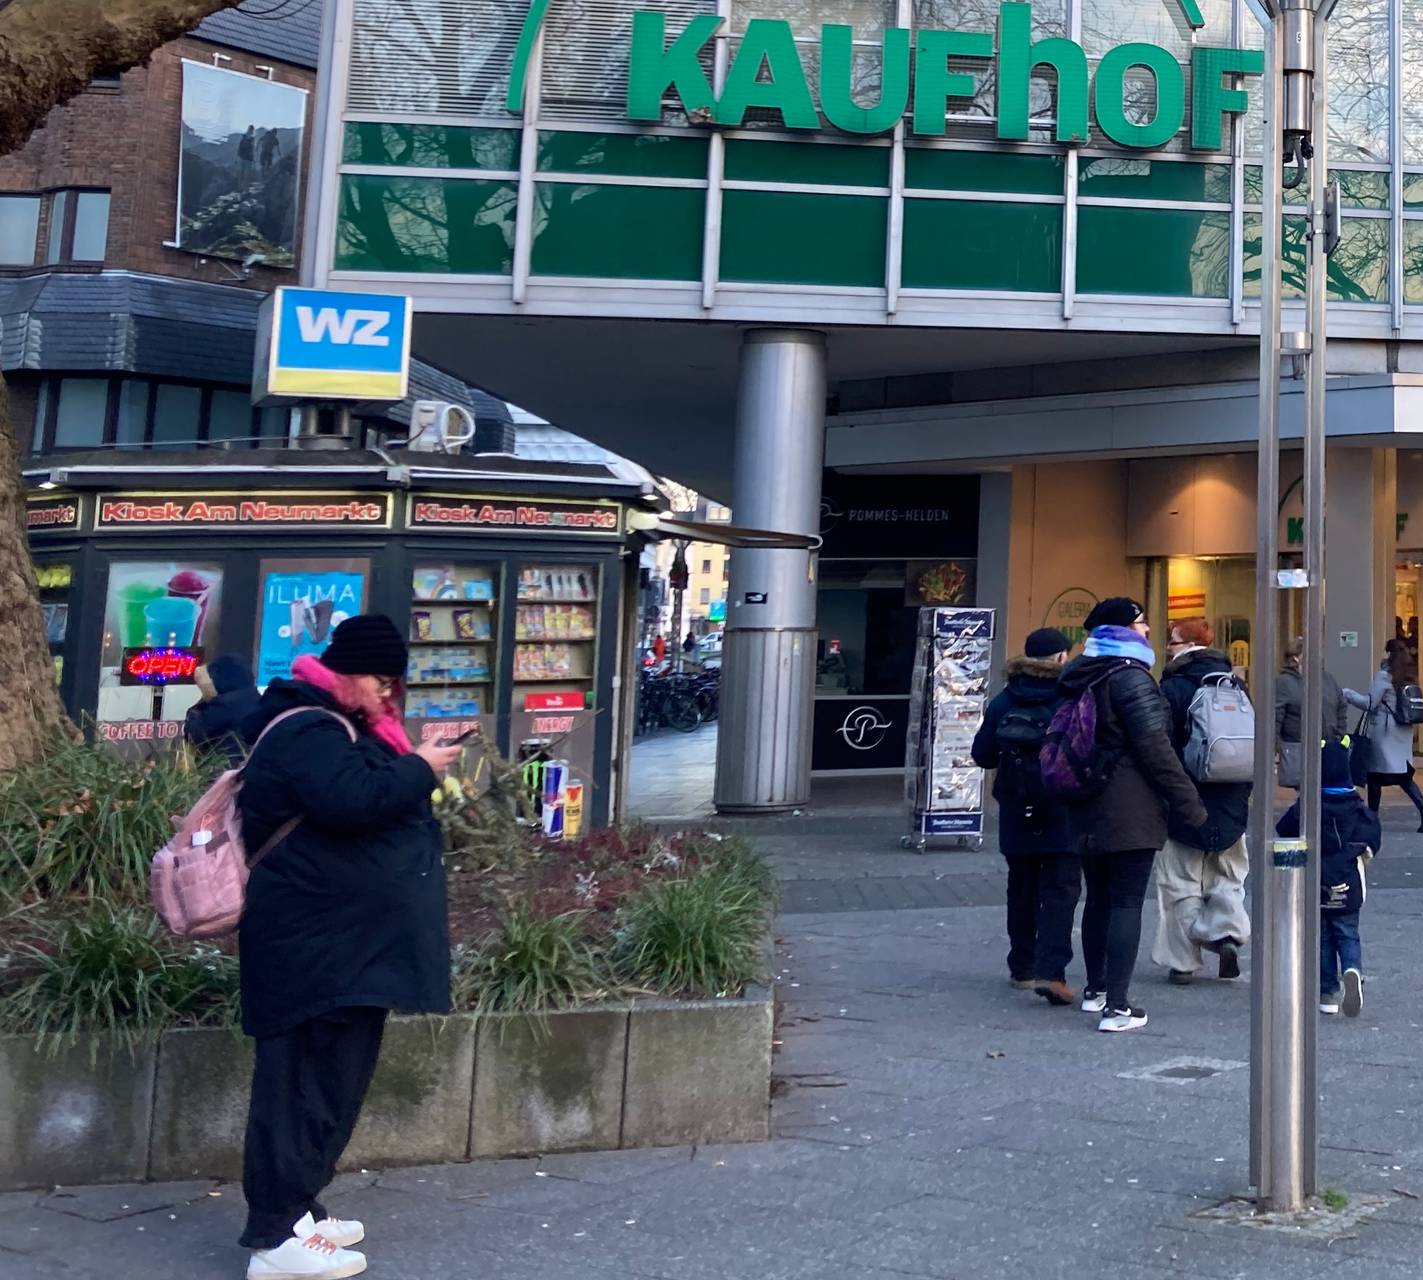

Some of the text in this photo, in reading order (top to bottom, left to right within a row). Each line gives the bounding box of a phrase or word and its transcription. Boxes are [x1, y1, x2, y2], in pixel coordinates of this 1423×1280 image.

[295, 306, 391, 346] WZ
[102, 501, 381, 521] Kiosk Am Neumarkt
[415, 503, 478, 522] Kiosk
[479, 505, 514, 523] Am
[848, 509, 950, 521] POMMES-HELDEN
[127, 655, 198, 676] OPEN
[157, 721, 179, 739] TO
